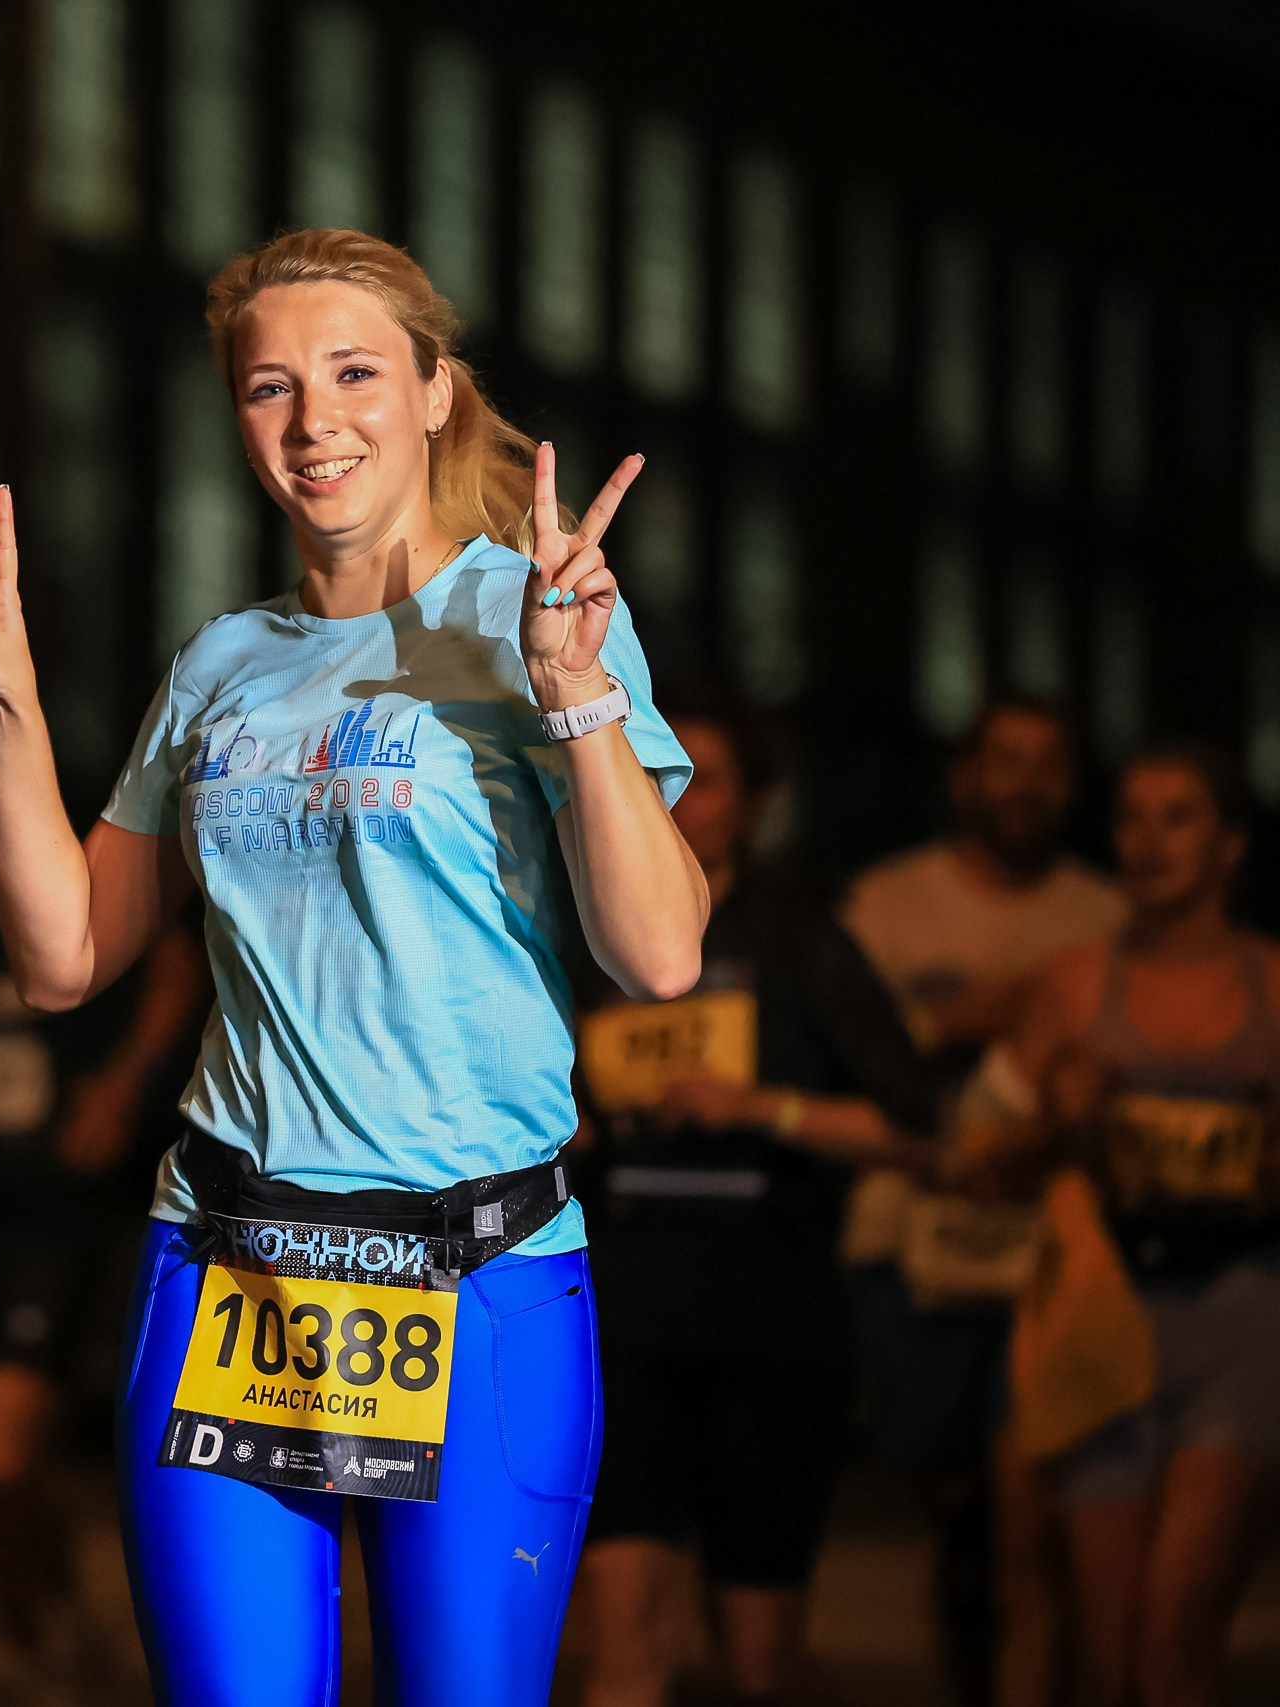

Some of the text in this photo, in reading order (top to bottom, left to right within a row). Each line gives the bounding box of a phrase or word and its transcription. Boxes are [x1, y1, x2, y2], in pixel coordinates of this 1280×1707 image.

[184, 777, 413, 821] OSCOW 2026
[193, 814, 413, 857] LF MARATHON
[232, 1221, 426, 1276] НОЧНОЙ
[308, 1268, 392, 1286] ЗАБЕГ
[213, 1293, 442, 1392] 10388
[242, 1383, 378, 1419] АНАСТАСИЯ
[189, 1424, 224, 1466] D
[364, 1457, 415, 1472] МОСКОВСКИЙ
[363, 1467, 388, 1480] СПОРТ
